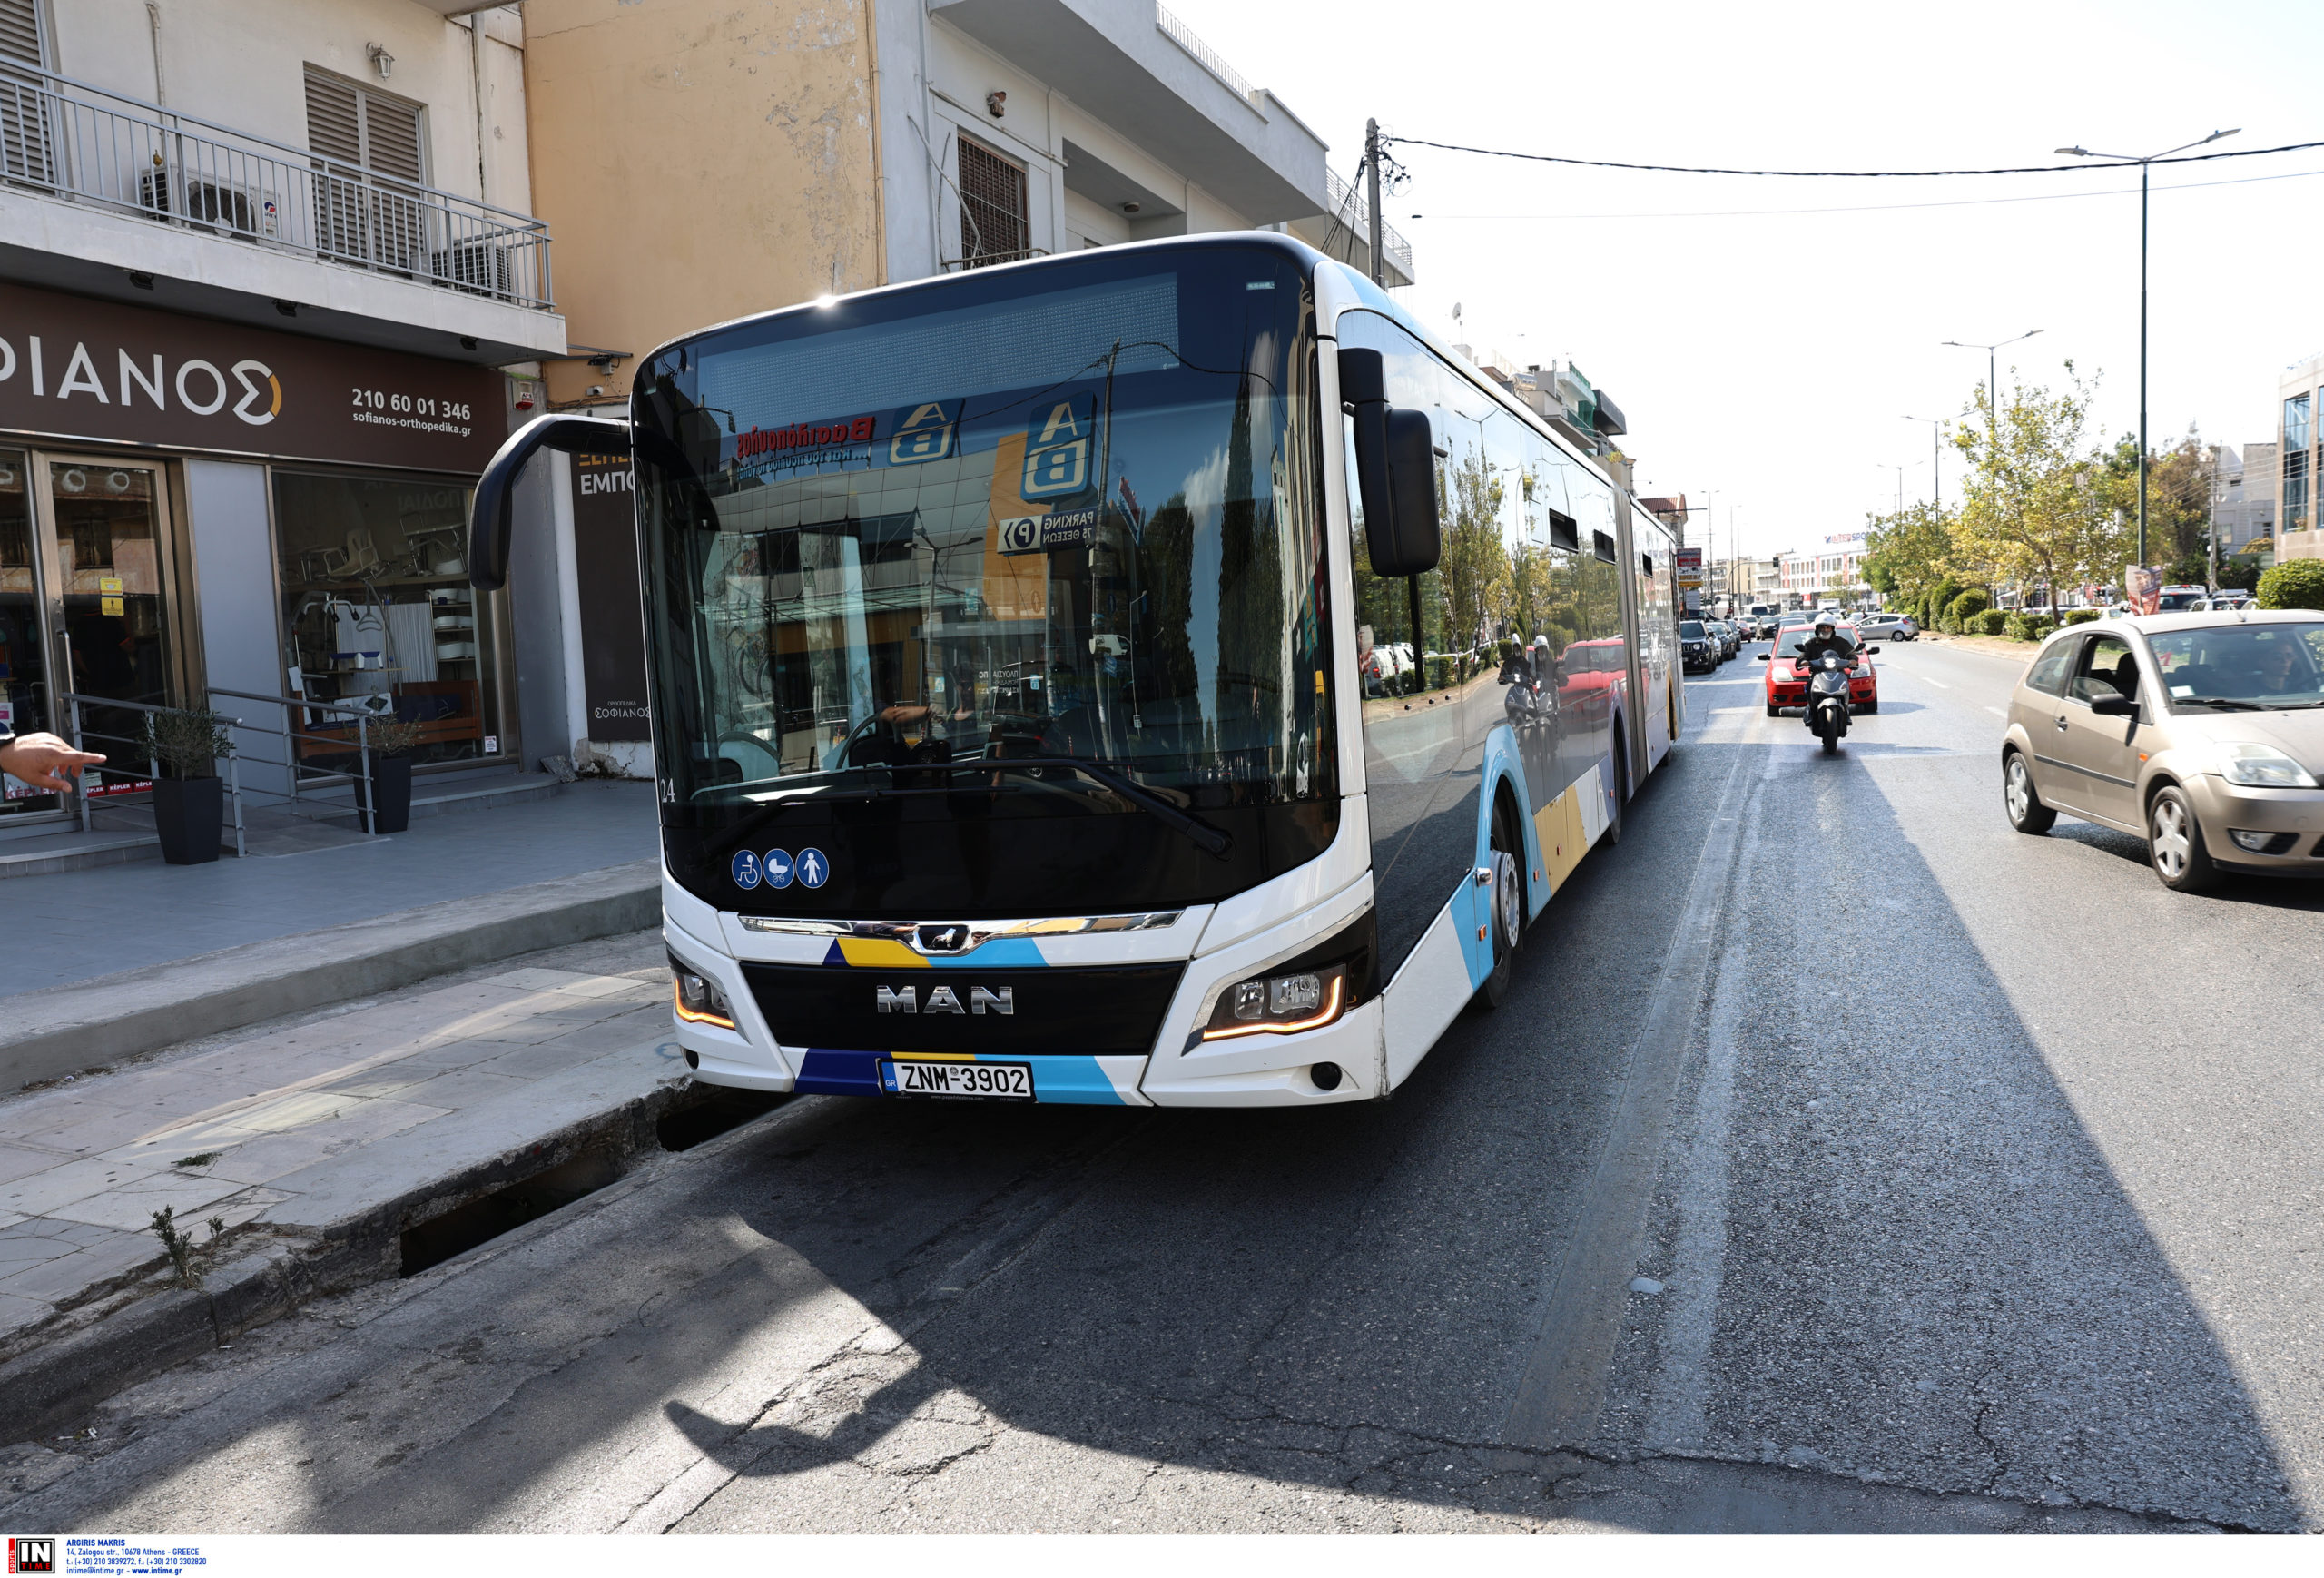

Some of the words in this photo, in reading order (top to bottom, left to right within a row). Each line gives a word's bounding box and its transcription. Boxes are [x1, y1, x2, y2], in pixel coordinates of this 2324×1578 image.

[351, 388, 385, 409] 210
[390, 393, 411, 412] 60
[417, 397, 436, 416] 01
[442, 401, 471, 421] 346
[352, 411, 472, 438] sofianos-orthopedika.gr
[660, 778, 675, 804] 24
[877, 985, 1014, 1015] MAN
[901, 1065, 1027, 1094] ZNM-3902
